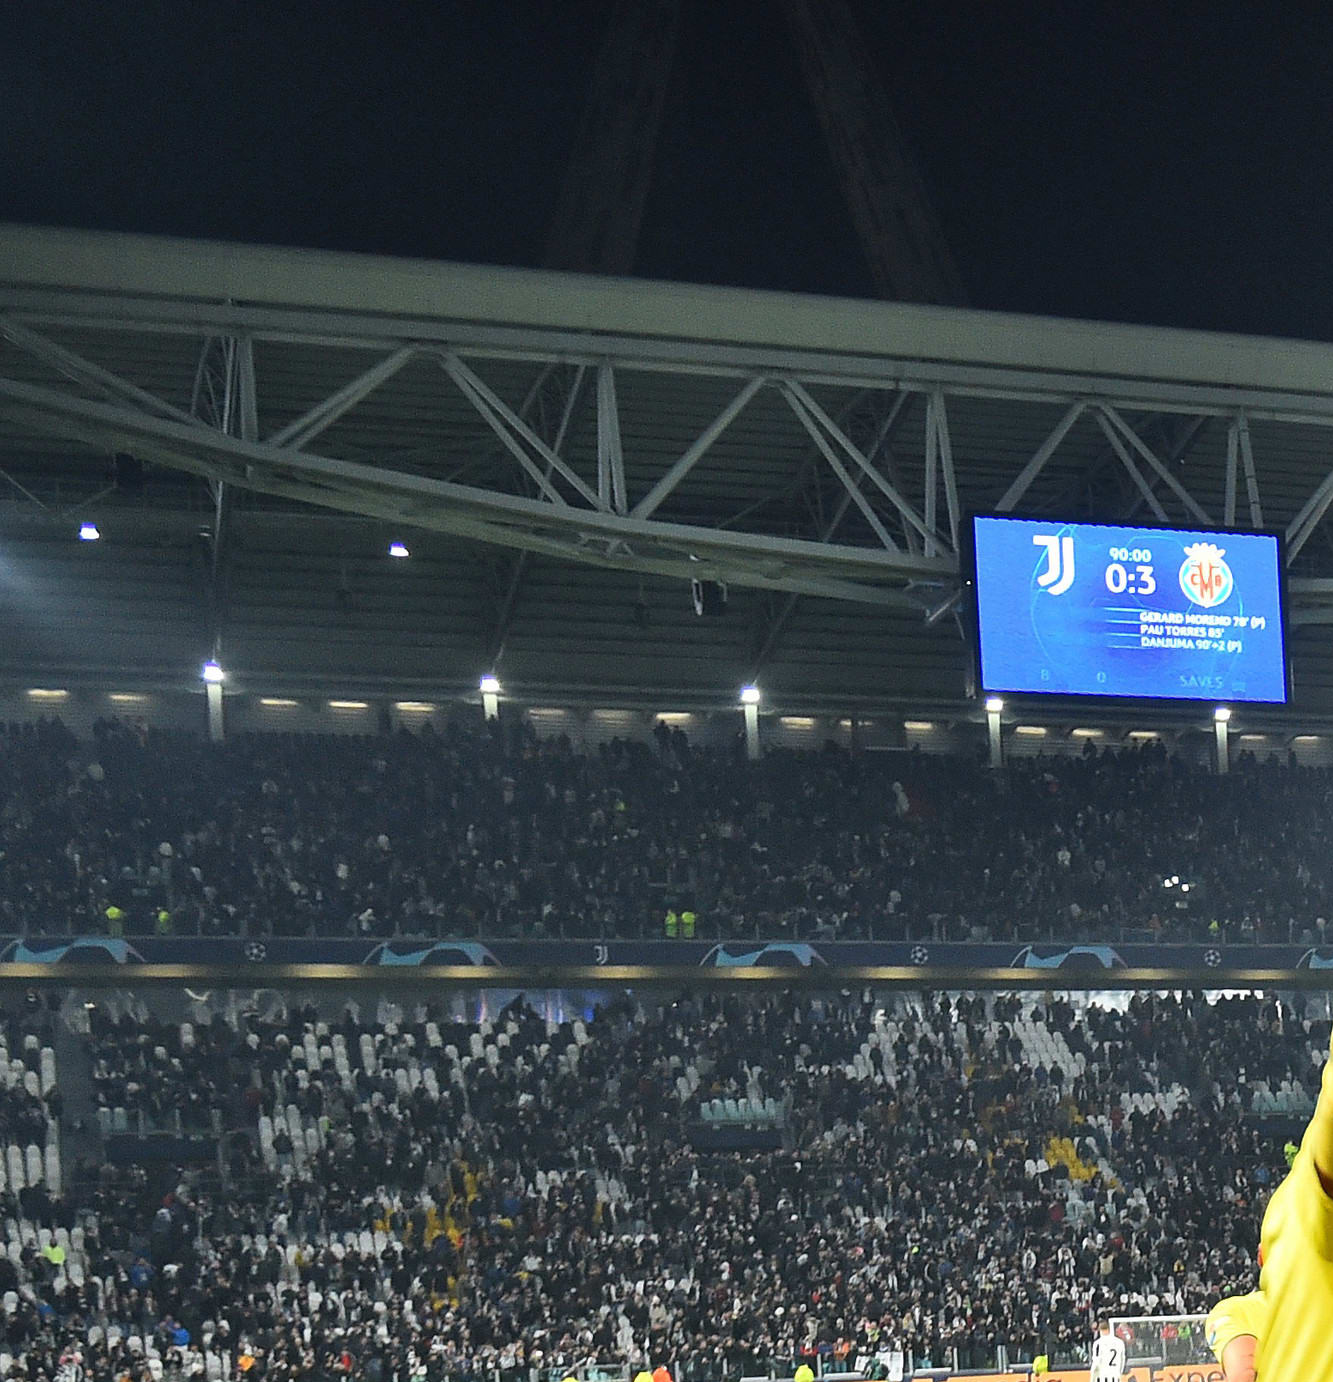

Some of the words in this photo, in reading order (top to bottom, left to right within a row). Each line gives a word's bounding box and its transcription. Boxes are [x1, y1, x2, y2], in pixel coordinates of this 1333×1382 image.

[1110, 547, 1152, 562] 90:00
[1105, 563, 1157, 595] 0:3
[1140, 611, 1184, 624] GERARD
[1185, 613, 1232, 626] MORENO
[1250, 615, 1266, 630] (P)
[1140, 624, 1163, 635] PAU
[1165, 625, 1207, 637] TORRES
[1141, 636, 1195, 649] DANJUMA
[1109, 1348, 1118, 1367] 2
